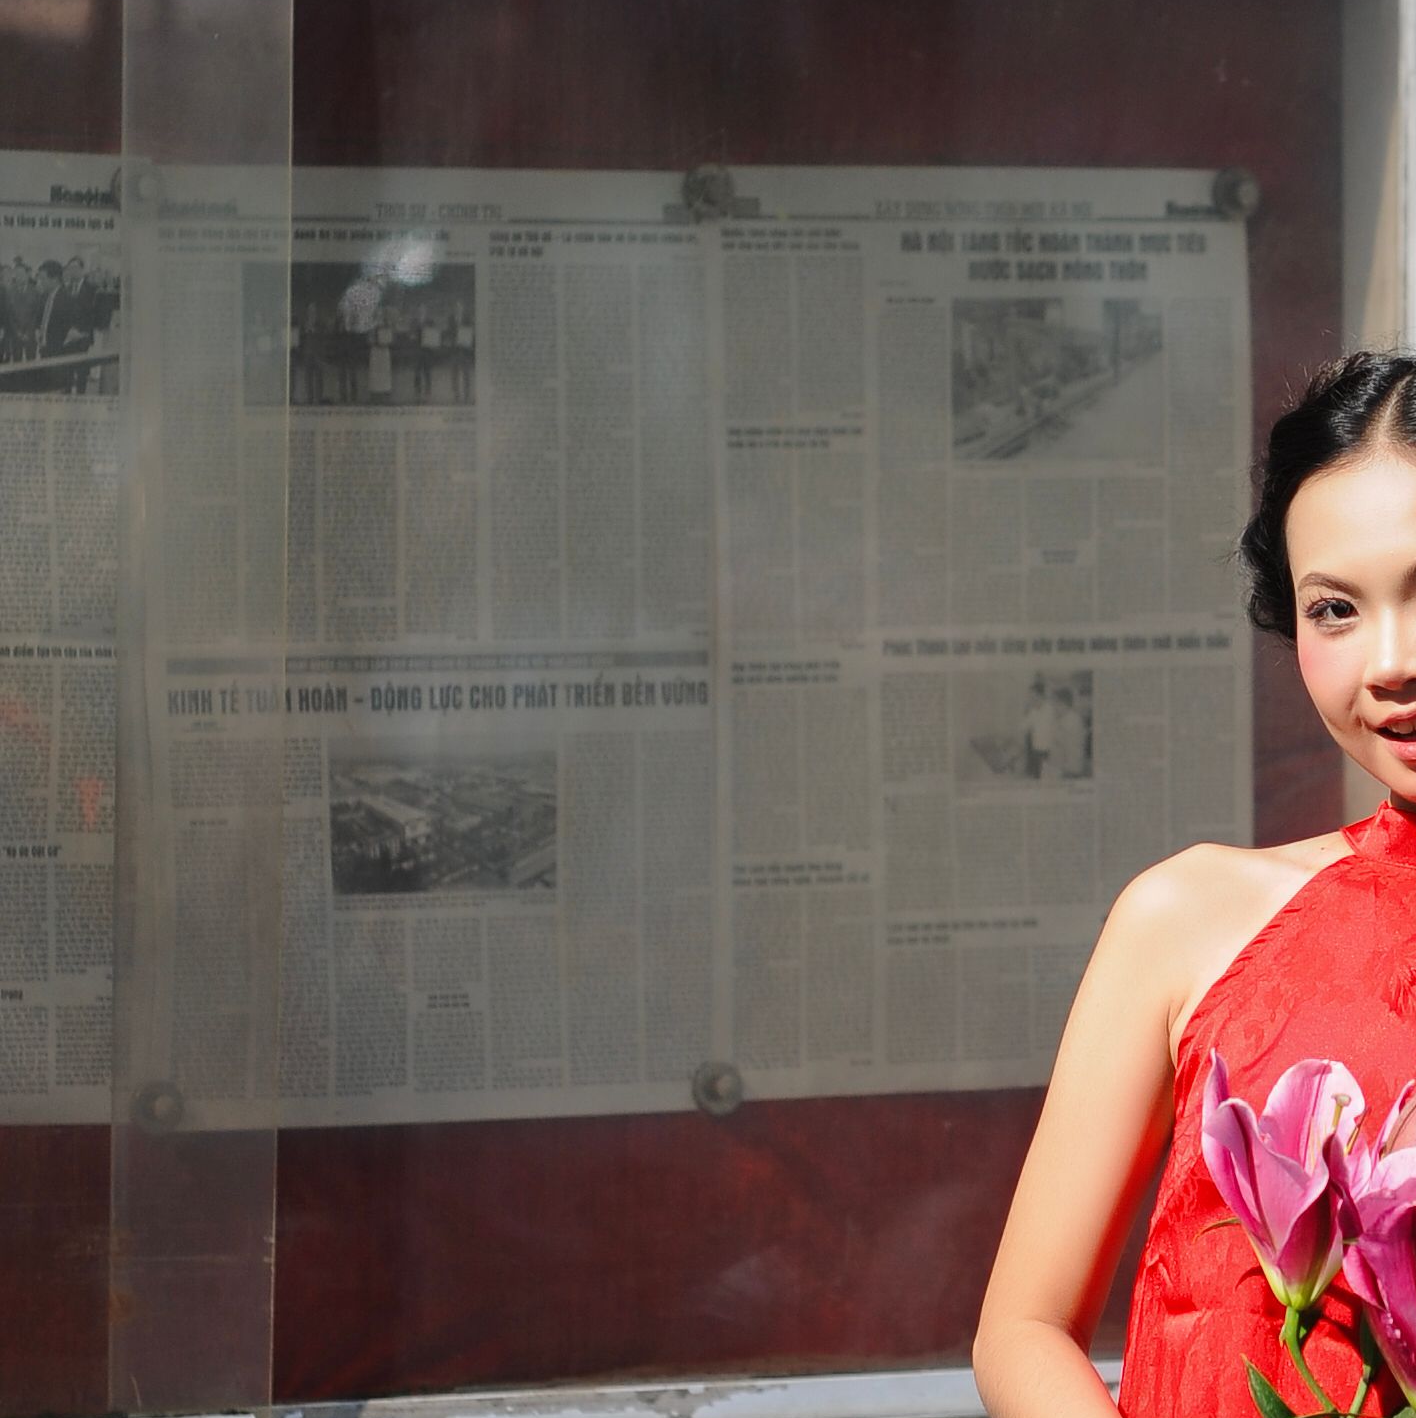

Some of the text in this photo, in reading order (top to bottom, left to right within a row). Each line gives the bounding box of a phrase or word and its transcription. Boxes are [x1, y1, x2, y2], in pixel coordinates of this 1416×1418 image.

[168, 689, 212, 714] KINH
[298, 682, 348, 713] HOÀN
[370, 681, 422, 716] ĐỘNG
[430, 684, 463, 715] LỰC
[470, 685, 507, 710] CHO
[514, 679, 558, 709] PHÁT
